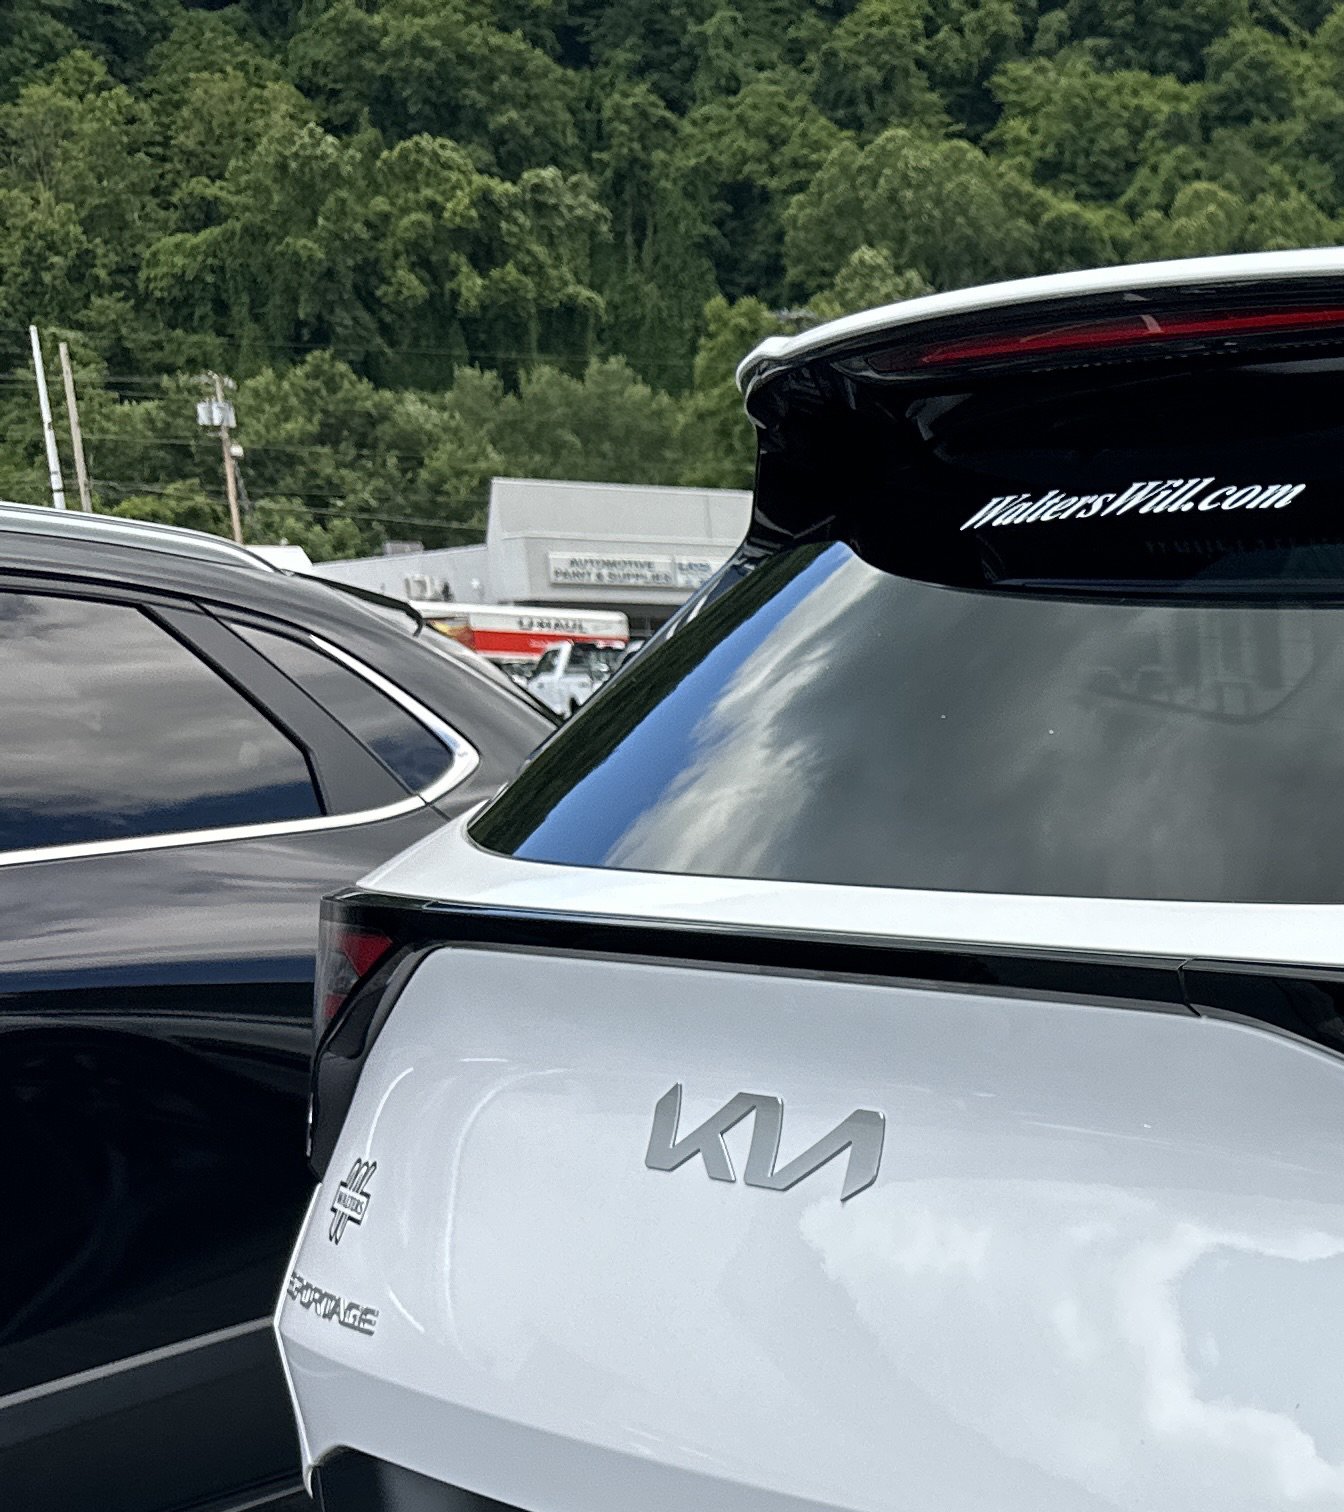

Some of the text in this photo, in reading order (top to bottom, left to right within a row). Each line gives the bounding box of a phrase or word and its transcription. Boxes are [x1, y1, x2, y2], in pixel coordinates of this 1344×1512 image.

[959, 476, 1306, 531] WaltersWill.com
[570, 557, 655, 570] AUTOMOTIVE
[608, 571, 672, 584] SUPPLIES
